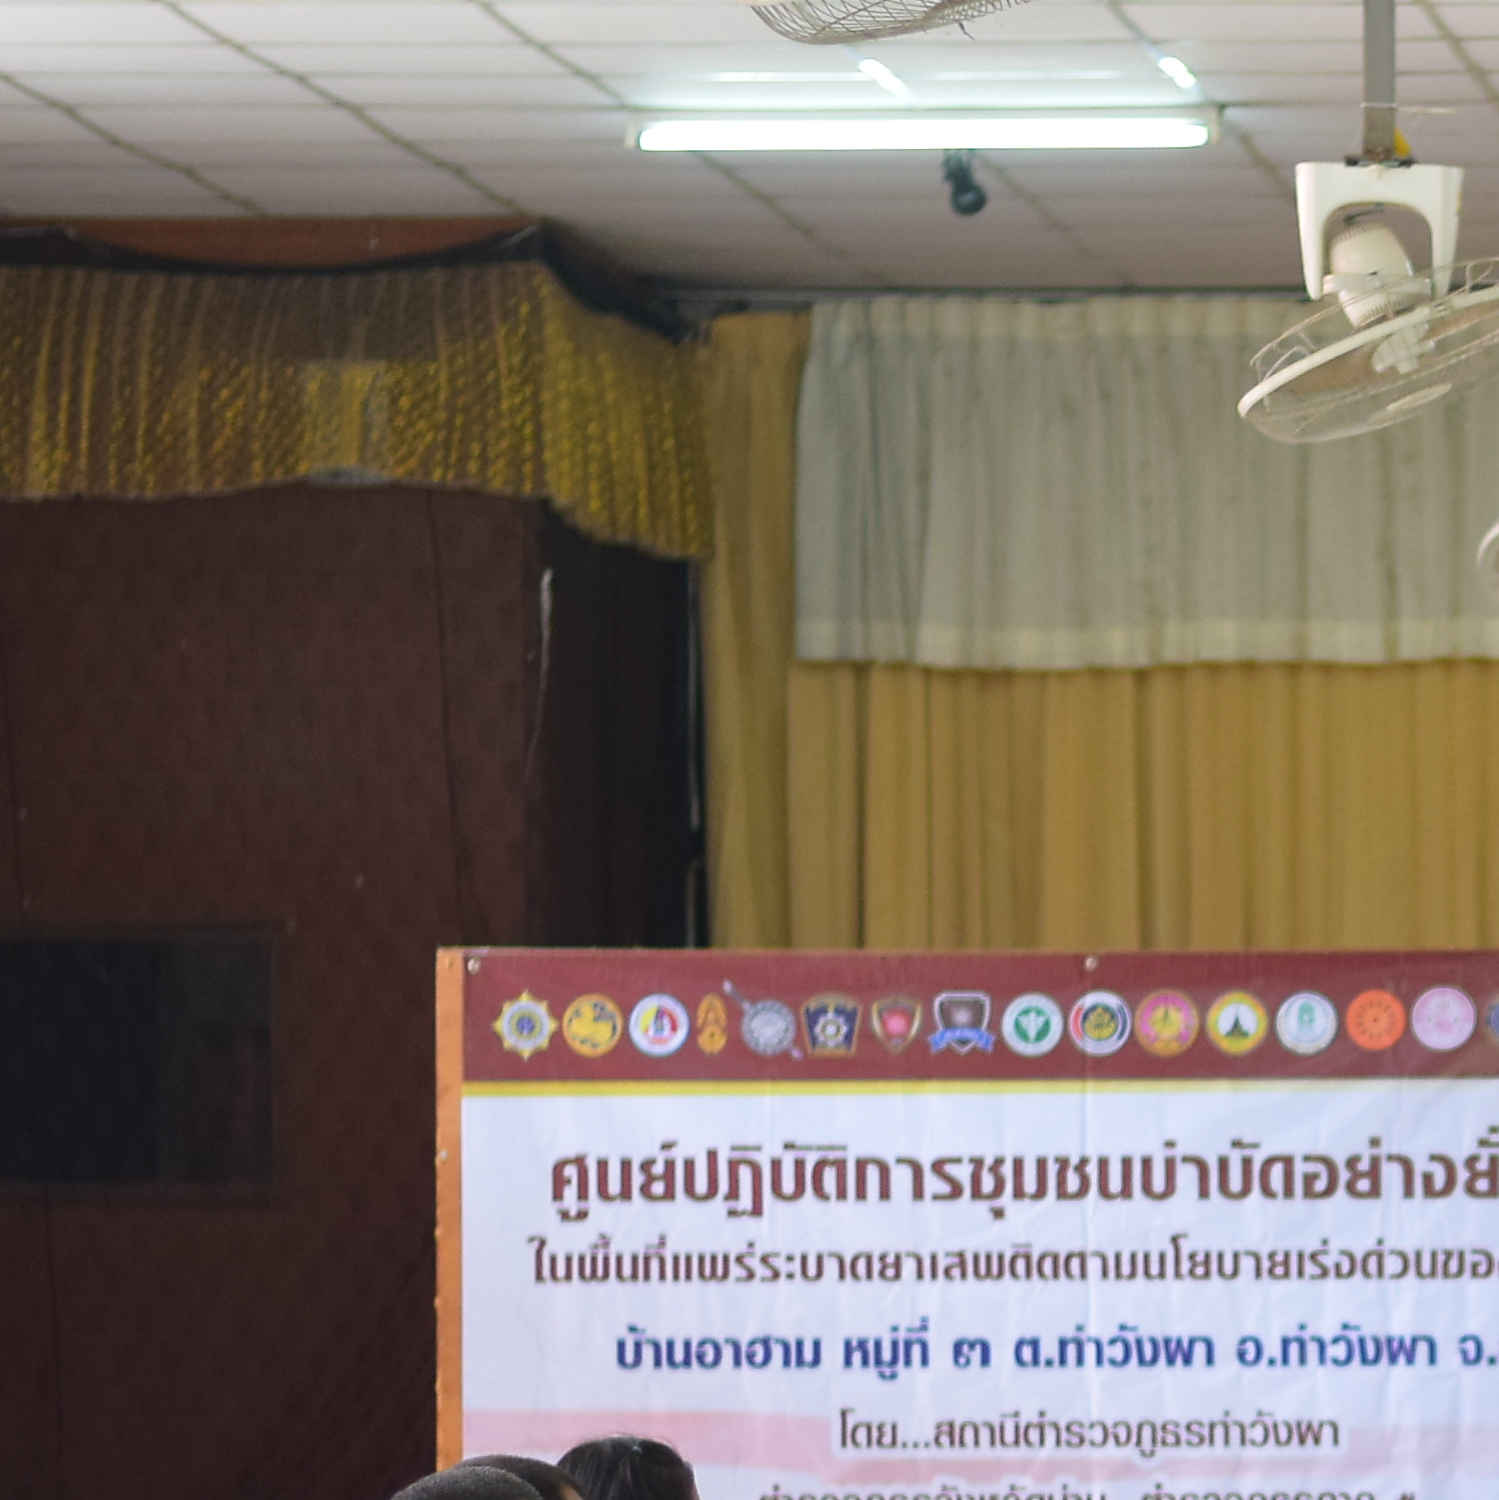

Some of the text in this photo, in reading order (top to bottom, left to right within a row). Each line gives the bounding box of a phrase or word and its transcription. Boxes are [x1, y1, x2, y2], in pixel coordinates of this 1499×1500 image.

[616, 1325, 822, 1370] บ้านอาฮาม
[843, 1317, 930, 1381] หมู่ที่
[1014, 1324, 1215, 1368] ต.ท่าวังผา
[1237, 1324, 1437, 1367] อ.ท่าวังผา
